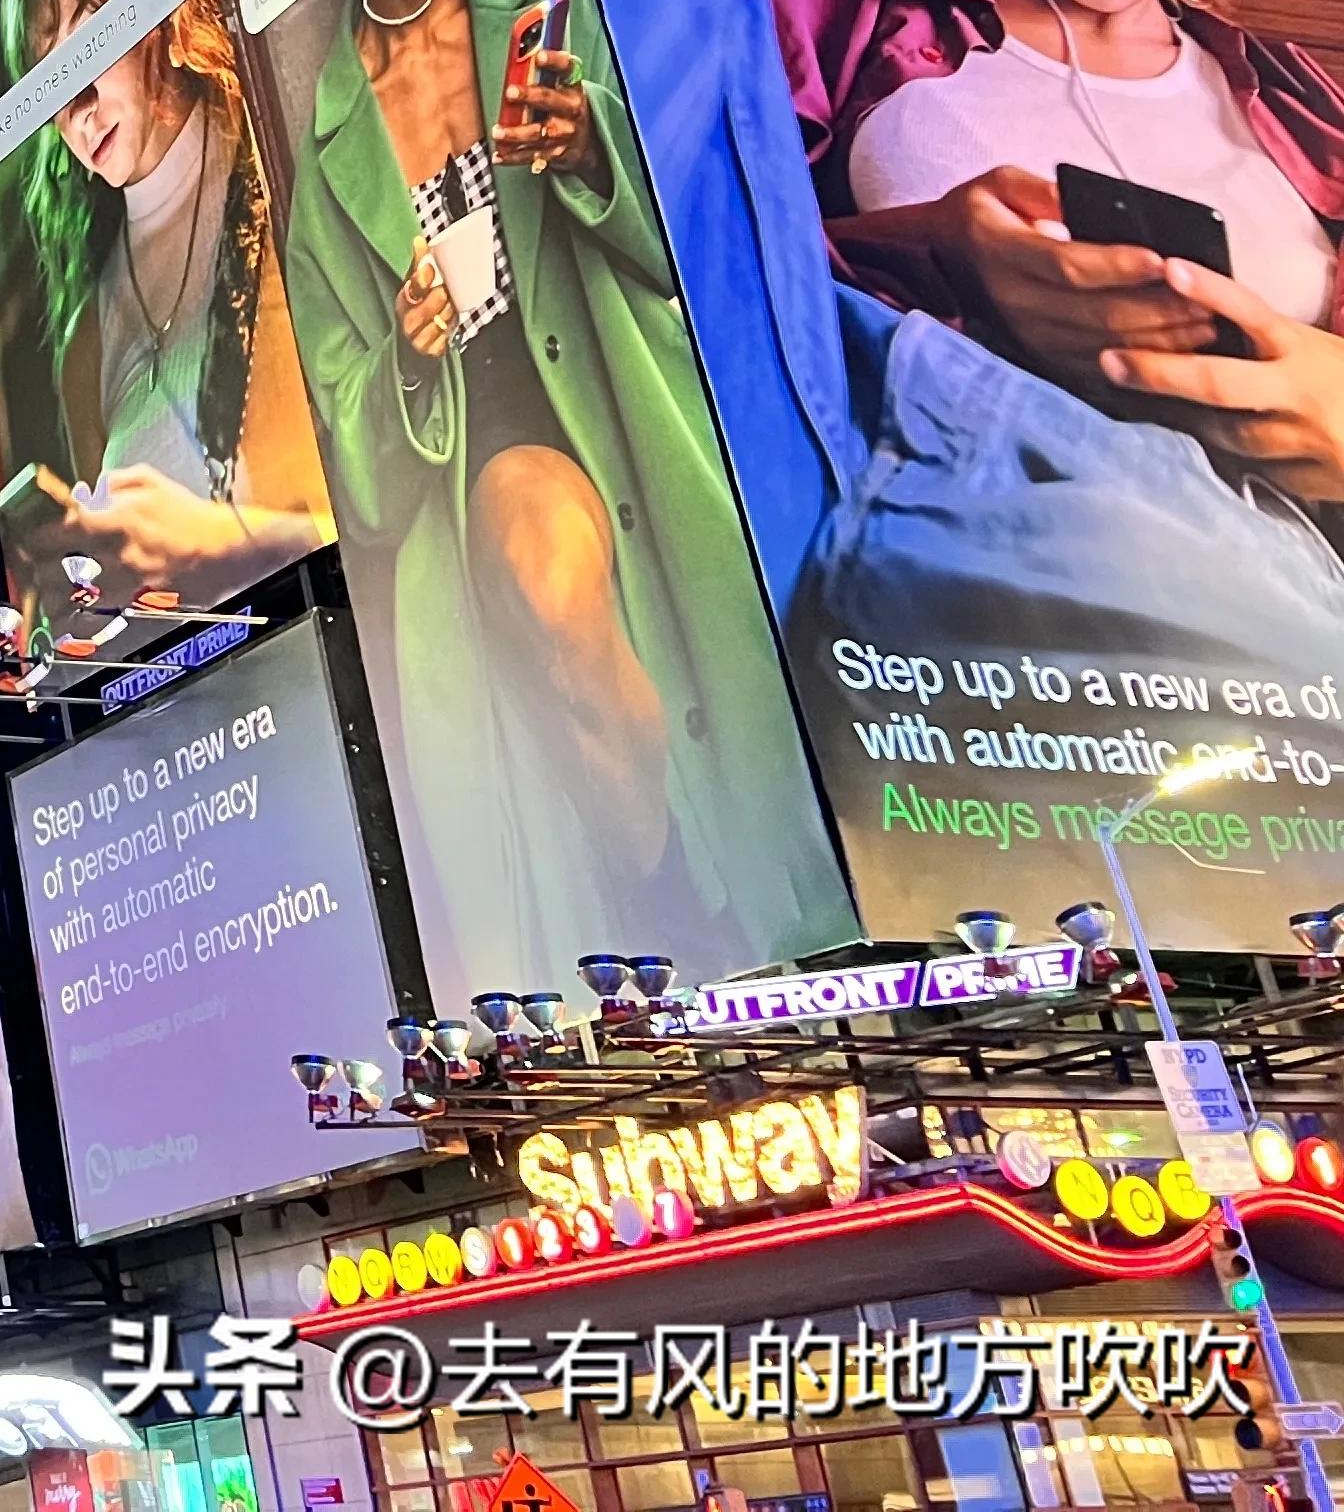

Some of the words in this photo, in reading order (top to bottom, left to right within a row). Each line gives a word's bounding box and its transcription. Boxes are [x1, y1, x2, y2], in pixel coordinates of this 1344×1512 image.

[14, 96, 32, 121] no
[70, 3, 137, 70] watching
[197, 621, 245, 659] PRIME
[832, 638, 943, 706] Step
[951, 659, 1015, 710] up
[1022, 654, 1072, 704] to
[1081, 667, 1115, 708] a
[1123, 668, 1212, 712] new
[1222, 675, 1296, 719] era
[1300, 673, 1343, 722] of
[32, 799, 85, 846] Step
[89, 782, 120, 824] up
[123, 767, 149, 803] to
[154, 757, 172, 790] a
[174, 727, 226, 780] new
[232, 704, 277, 752] era
[853, 712, 951, 766] with
[965, 723, 1179, 779] automatic
[43, 856, 64, 901] of
[69, 810, 167, 897] personal
[172, 774, 259, 852] privacy
[883, 781, 1040, 851] Always
[1050, 799, 1251, 861] message
[50, 903, 96, 954] with
[102, 856, 217, 934] automatic
[60, 929, 189, 1015] end-to-end
[194, 881, 339, 964] encryption.
[1161, 1048, 1207, 1064] NYPD
[518, 1085, 864, 1217] Subway
[1070, 1171, 1098, 1204] N
[1129, 1189, 1156, 1222] Q
[1311, 1145, 1337, 1185] 1
[365, 1258, 383, 1287] Q
[428, 1246, 451, 1279] W
[502, 1225, 523, 1263] 1
[536, 1217, 562, 1260] 2
[575, 1208, 601, 1250] 3
[654, 1190, 677, 1238] 7
